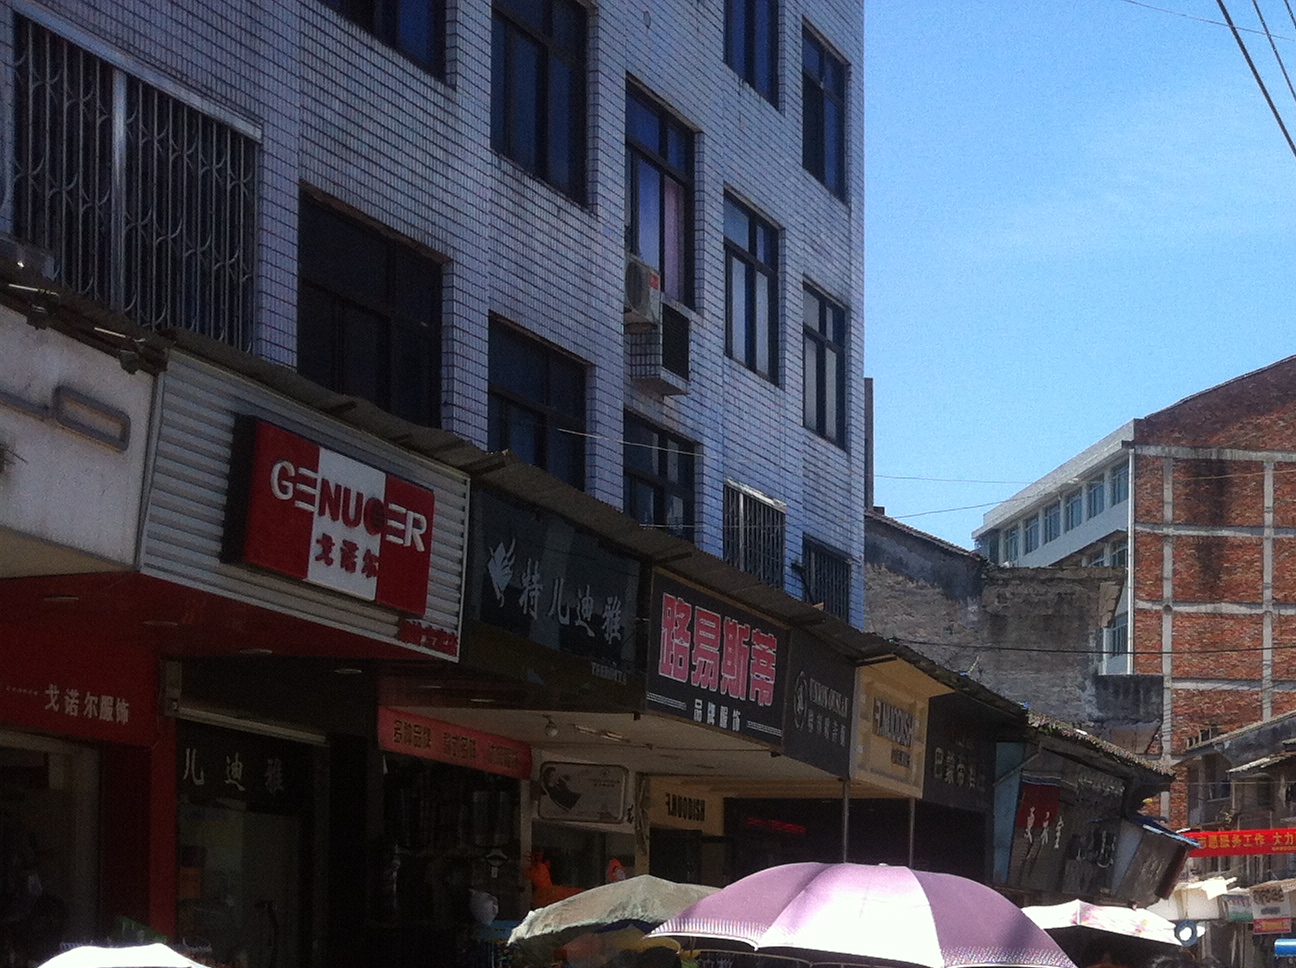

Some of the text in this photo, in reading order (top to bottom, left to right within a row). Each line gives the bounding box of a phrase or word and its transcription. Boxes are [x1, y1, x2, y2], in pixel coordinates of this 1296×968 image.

[315, 533, 380, 579] 戈诺尔
[44, 683, 130, 725] 戈诺尔服饰
